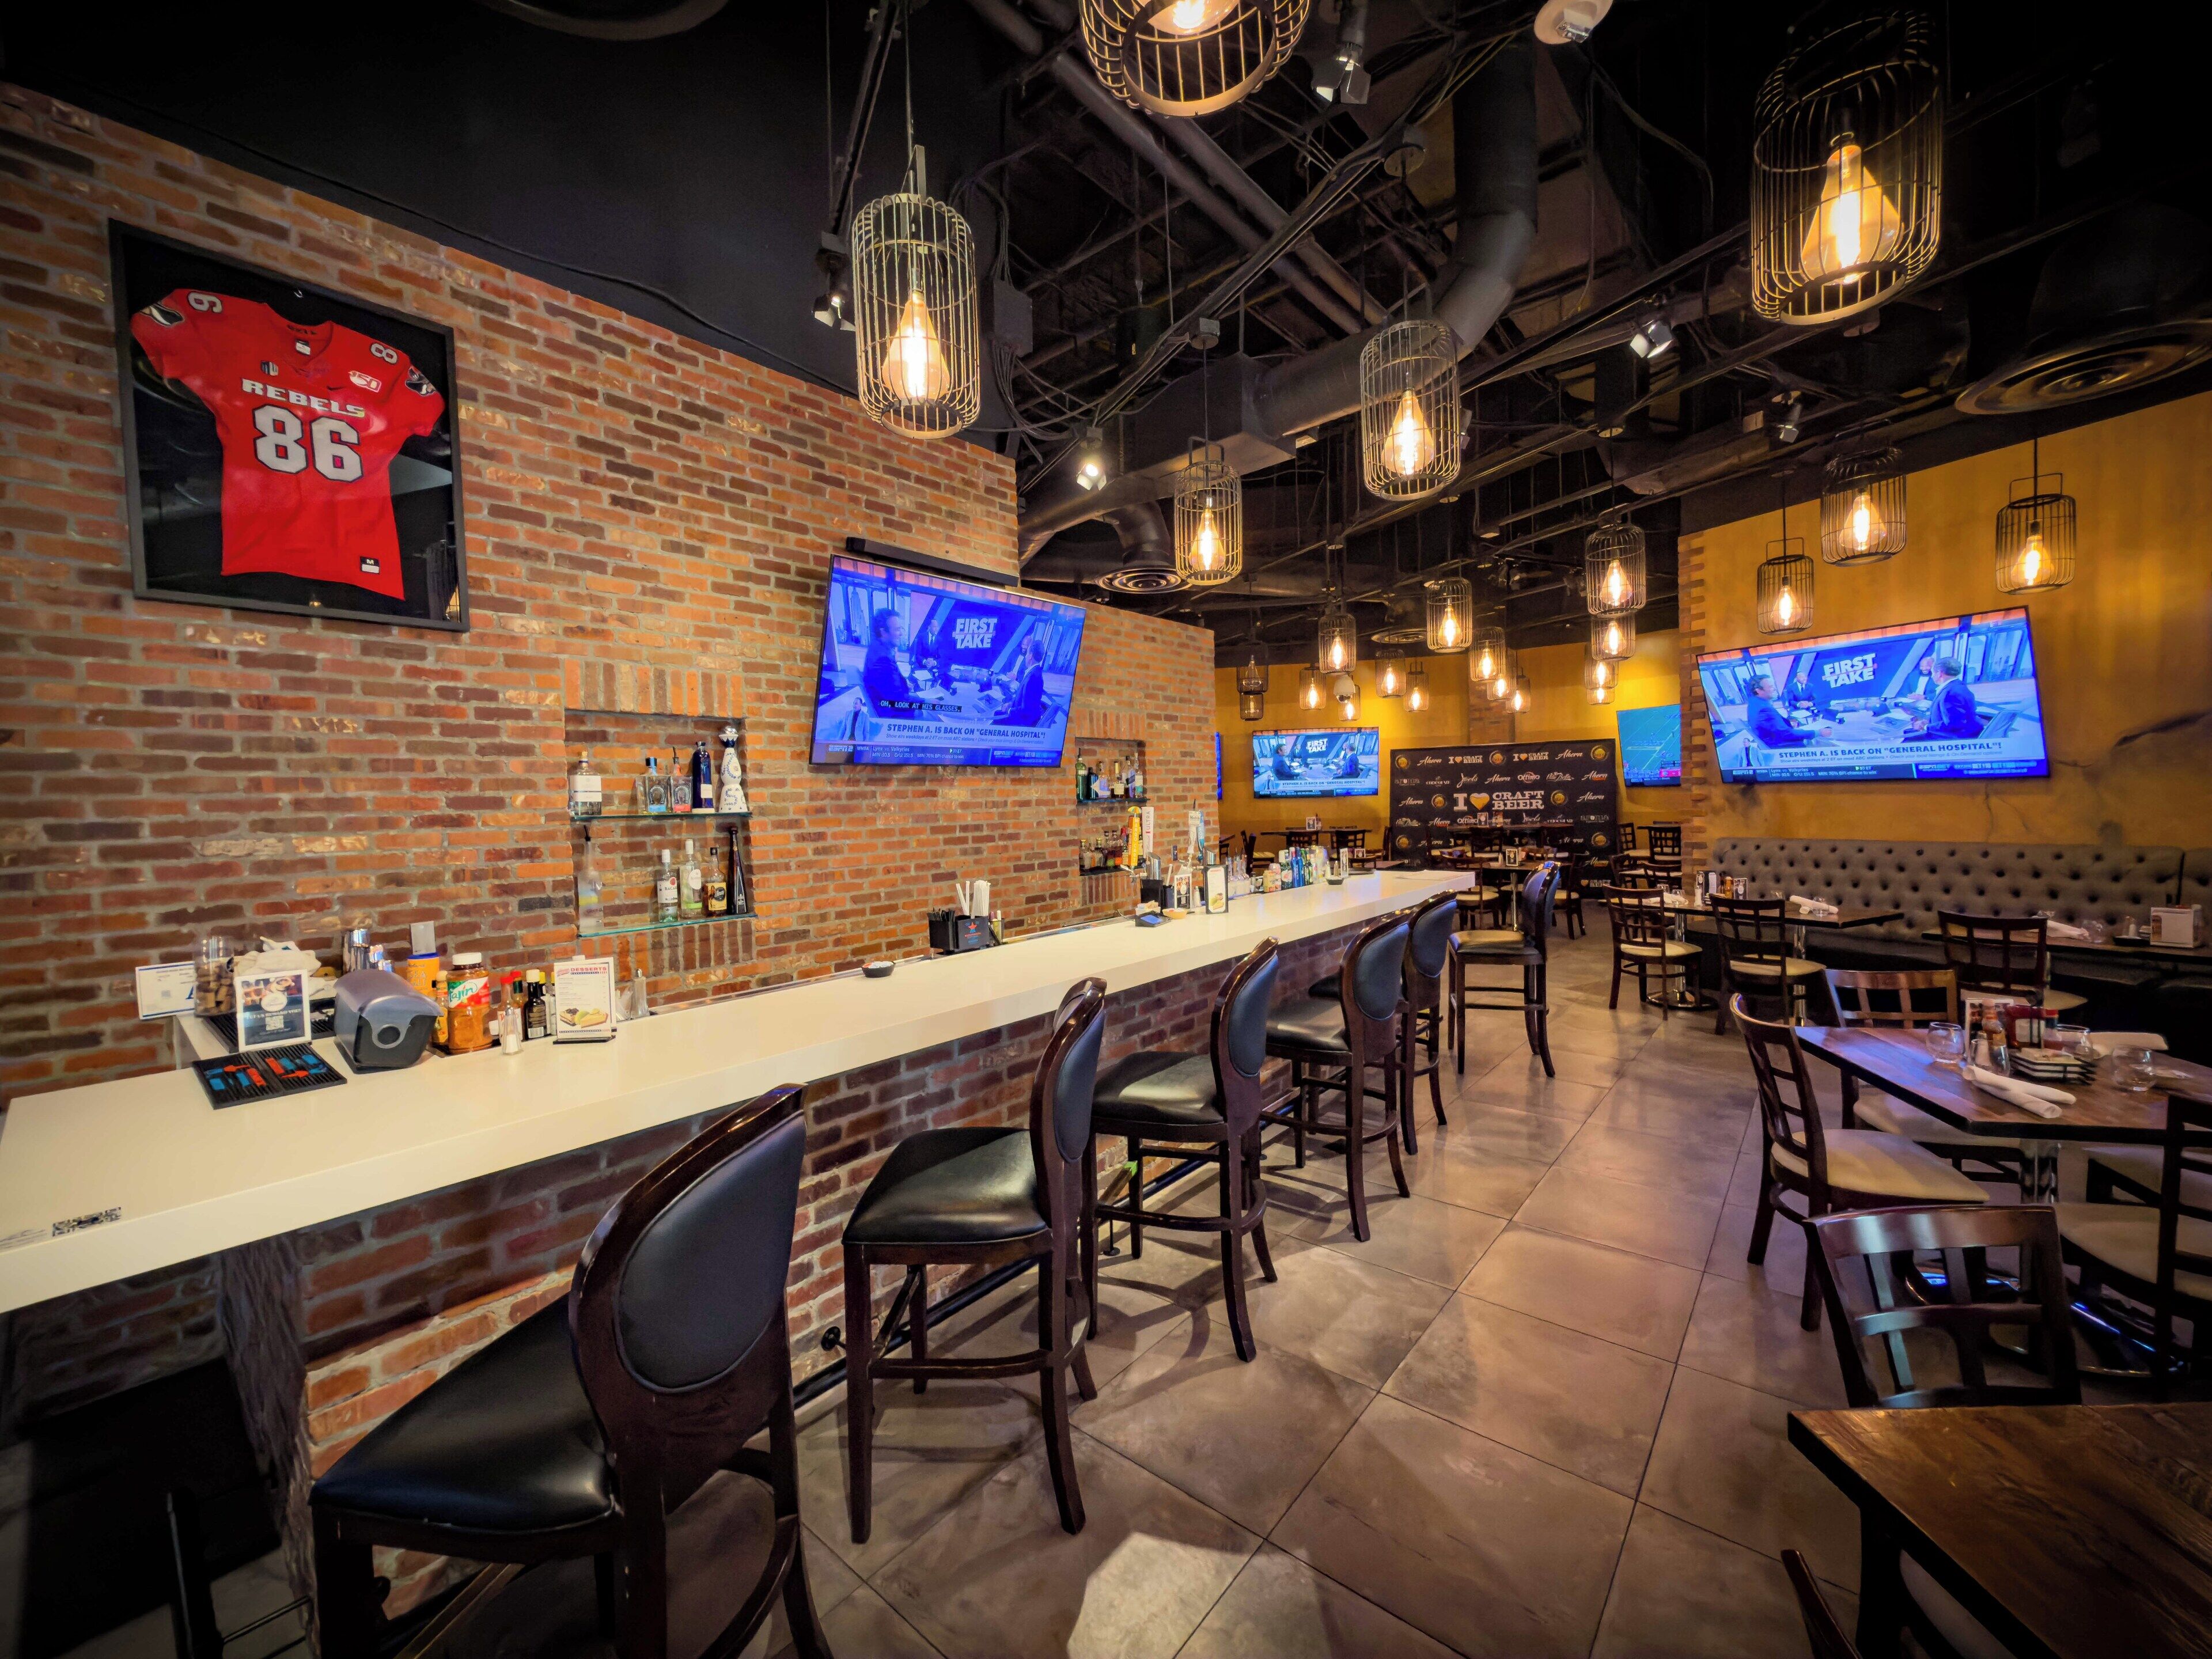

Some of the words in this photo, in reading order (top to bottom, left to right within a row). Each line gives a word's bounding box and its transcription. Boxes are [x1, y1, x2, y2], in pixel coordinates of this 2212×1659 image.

[370, 342, 398, 365] 8
[242, 377, 366, 418] REBELS
[252, 404, 364, 483] 86
[956, 618, 998, 634] FIRST
[955, 634, 993, 649] TAKE
[1823, 653, 1876, 677] FIRST
[1825, 667, 1874, 688] TAKE
[880, 700, 891, 709] OH,
[887, 724, 923, 733] STEPHEN
[944, 727, 963, 735] BACK
[976, 729, 1009, 737] "GENERAL
[1011, 730, 1046, 738] HOSPITAL"!
[1306, 738, 1328, 747] FIRST
[1884, 745, 1936, 753] "GENERAL
[1938, 742, 2002, 751] HOSPITAL"!
[1555, 749, 1583, 760] Ahern
[1581, 770, 1608, 781] Ahern
[1453, 793, 1468, 811] I
[1492, 790, 1544, 800] CRAFT
[1492, 800, 1544, 810] BEER
